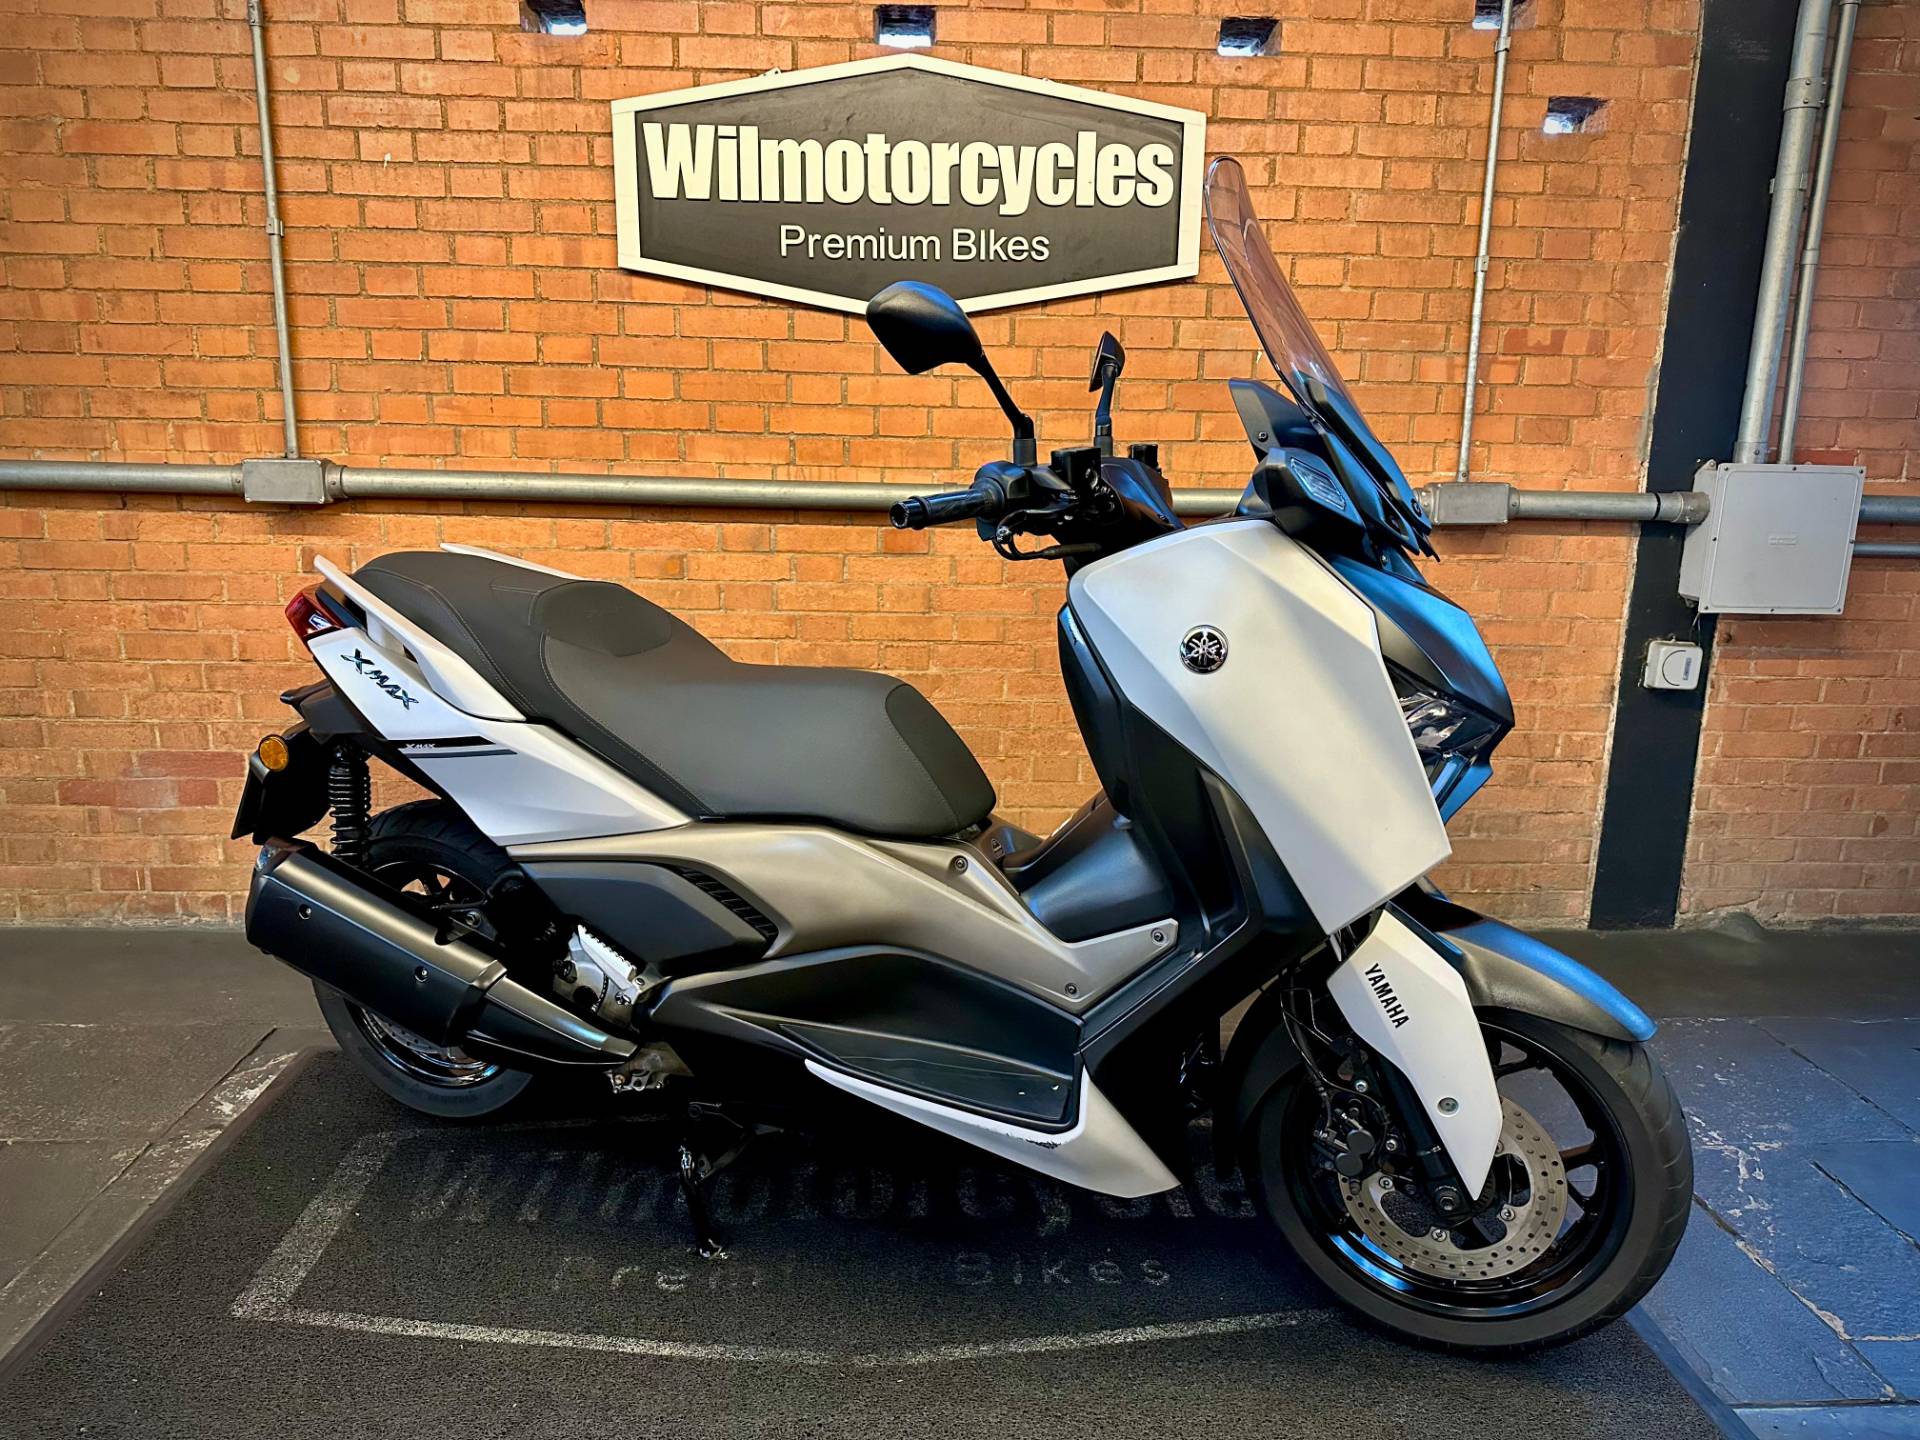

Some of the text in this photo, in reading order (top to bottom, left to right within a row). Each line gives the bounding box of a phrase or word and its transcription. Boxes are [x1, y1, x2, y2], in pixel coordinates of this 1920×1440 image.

[642, 121, 1175, 216] Wilmotorcycles
[779, 224, 941, 261] Premium
[1364, 962, 1410, 1029] YAMAHA
